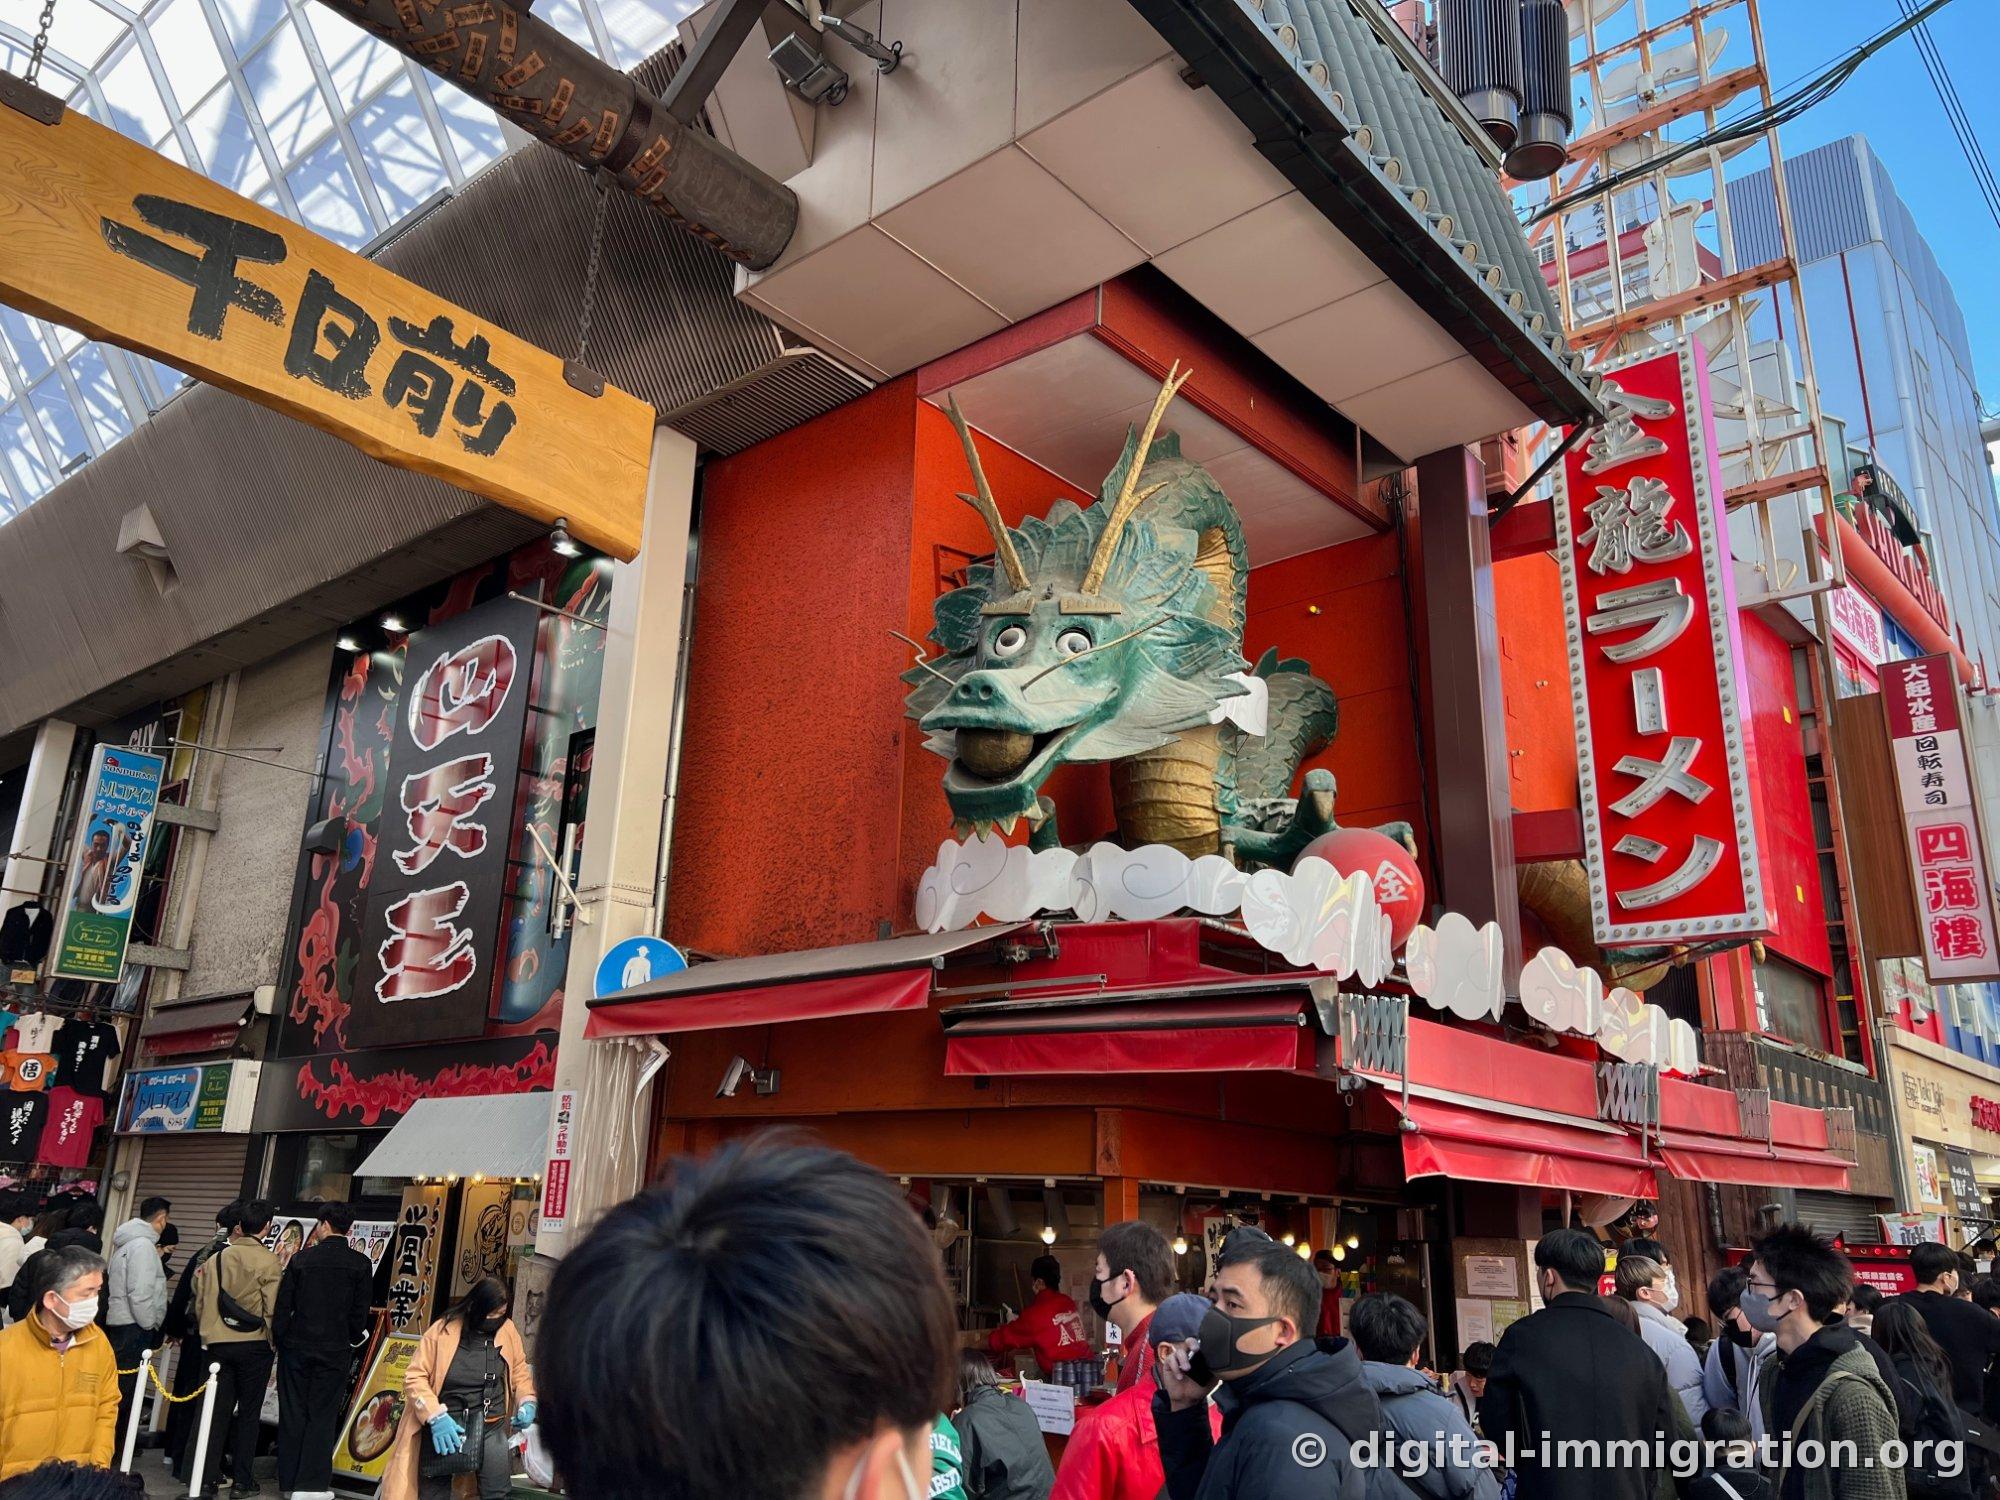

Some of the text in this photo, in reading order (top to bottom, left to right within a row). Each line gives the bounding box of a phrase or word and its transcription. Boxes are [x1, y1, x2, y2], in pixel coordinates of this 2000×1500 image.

[101, 193, 516, 456] 千日前
[1570, 379, 1725, 911] 金龍ラーメン
[1902, 663, 1938, 734] 大起水産
[97, 779, 155, 806] トルコアイス
[375, 634, 516, 1003] 四天王
[1915, 735, 1948, 806] 回転寿司
[1373, 860, 1413, 903] 金
[1915, 822, 1987, 961] 四海樓
